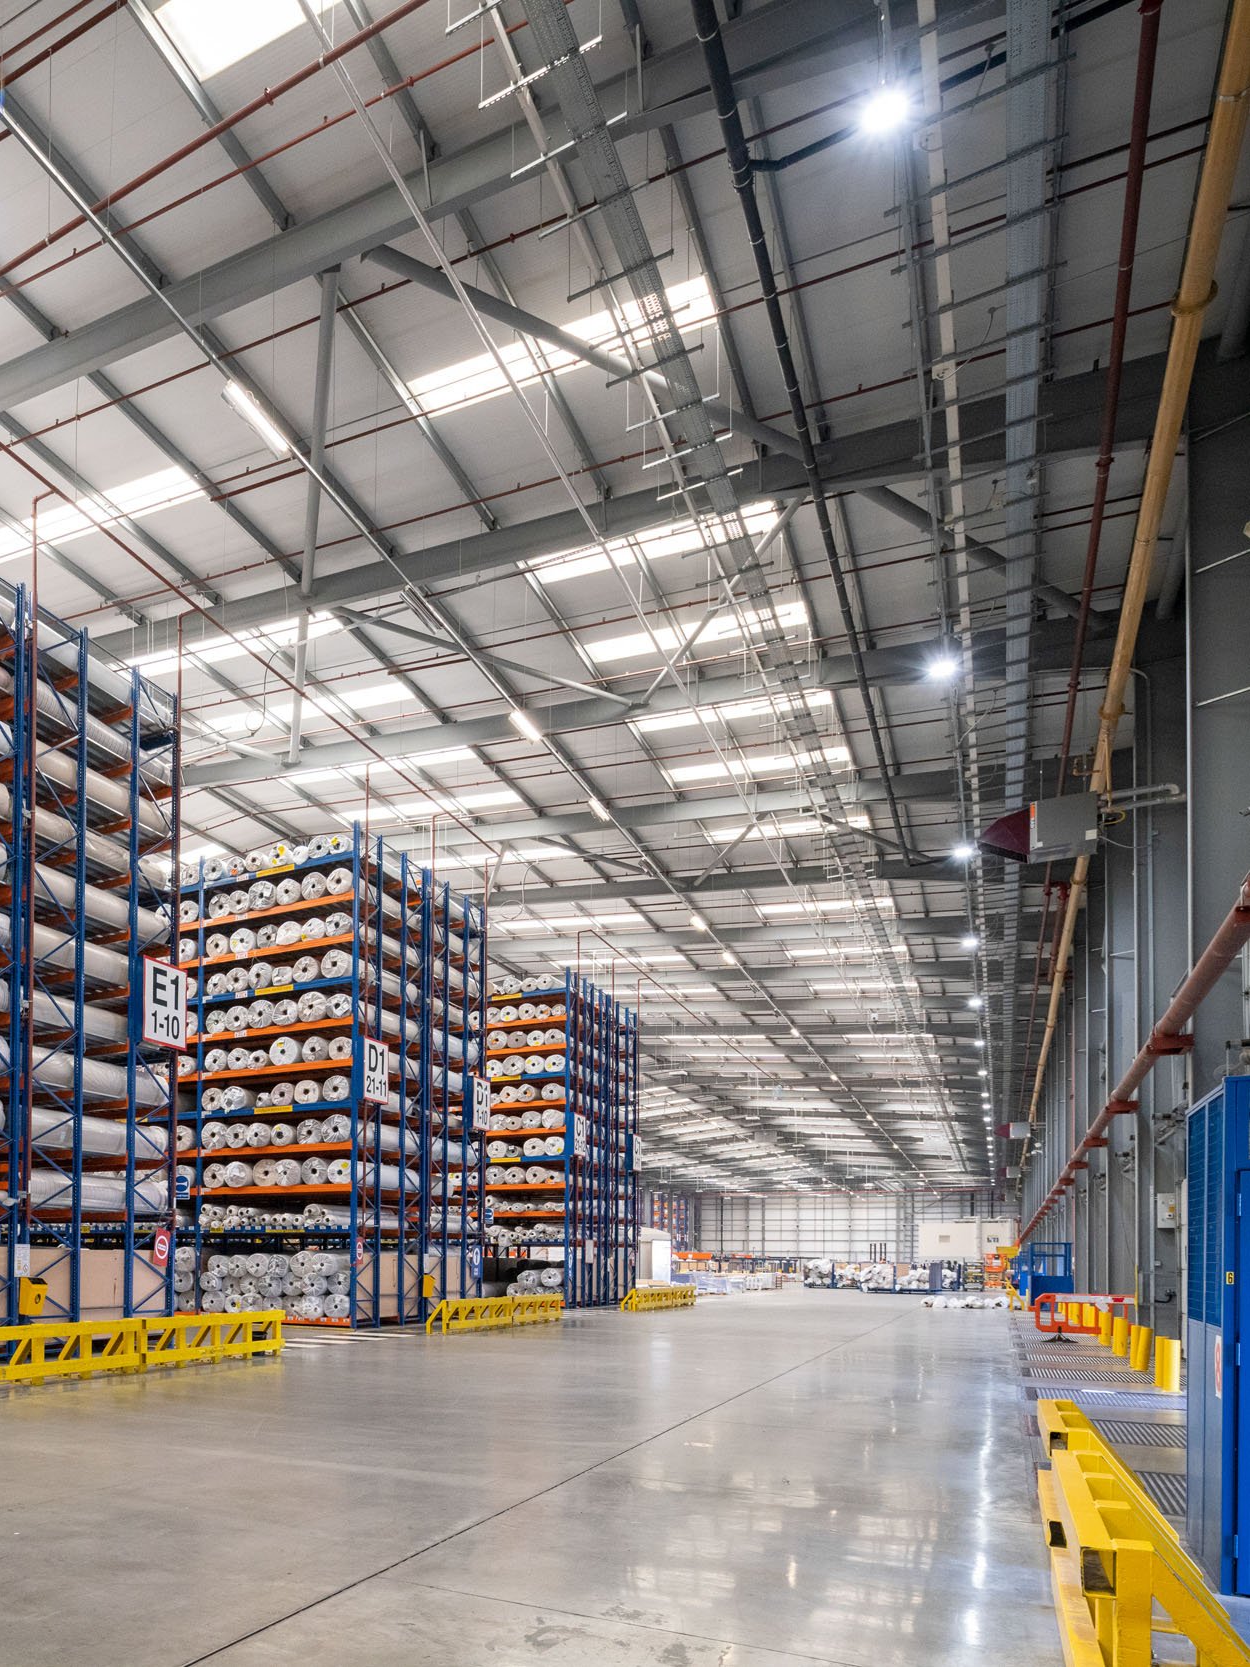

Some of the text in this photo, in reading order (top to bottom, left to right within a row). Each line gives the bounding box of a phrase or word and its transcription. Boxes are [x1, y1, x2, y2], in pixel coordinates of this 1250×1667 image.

[152, 966, 180, 1010] E1
[151, 1010, 180, 1040] 1-10
[368, 1043, 385, 1075] D1
[366, 1075, 387, 1097] 21-11
[476, 1081, 488, 1107] D1
[476, 1108, 488, 1126] 1-10
[576, 1117, 585, 1138] C1
[1227, 1272, 1232, 1283] 6
